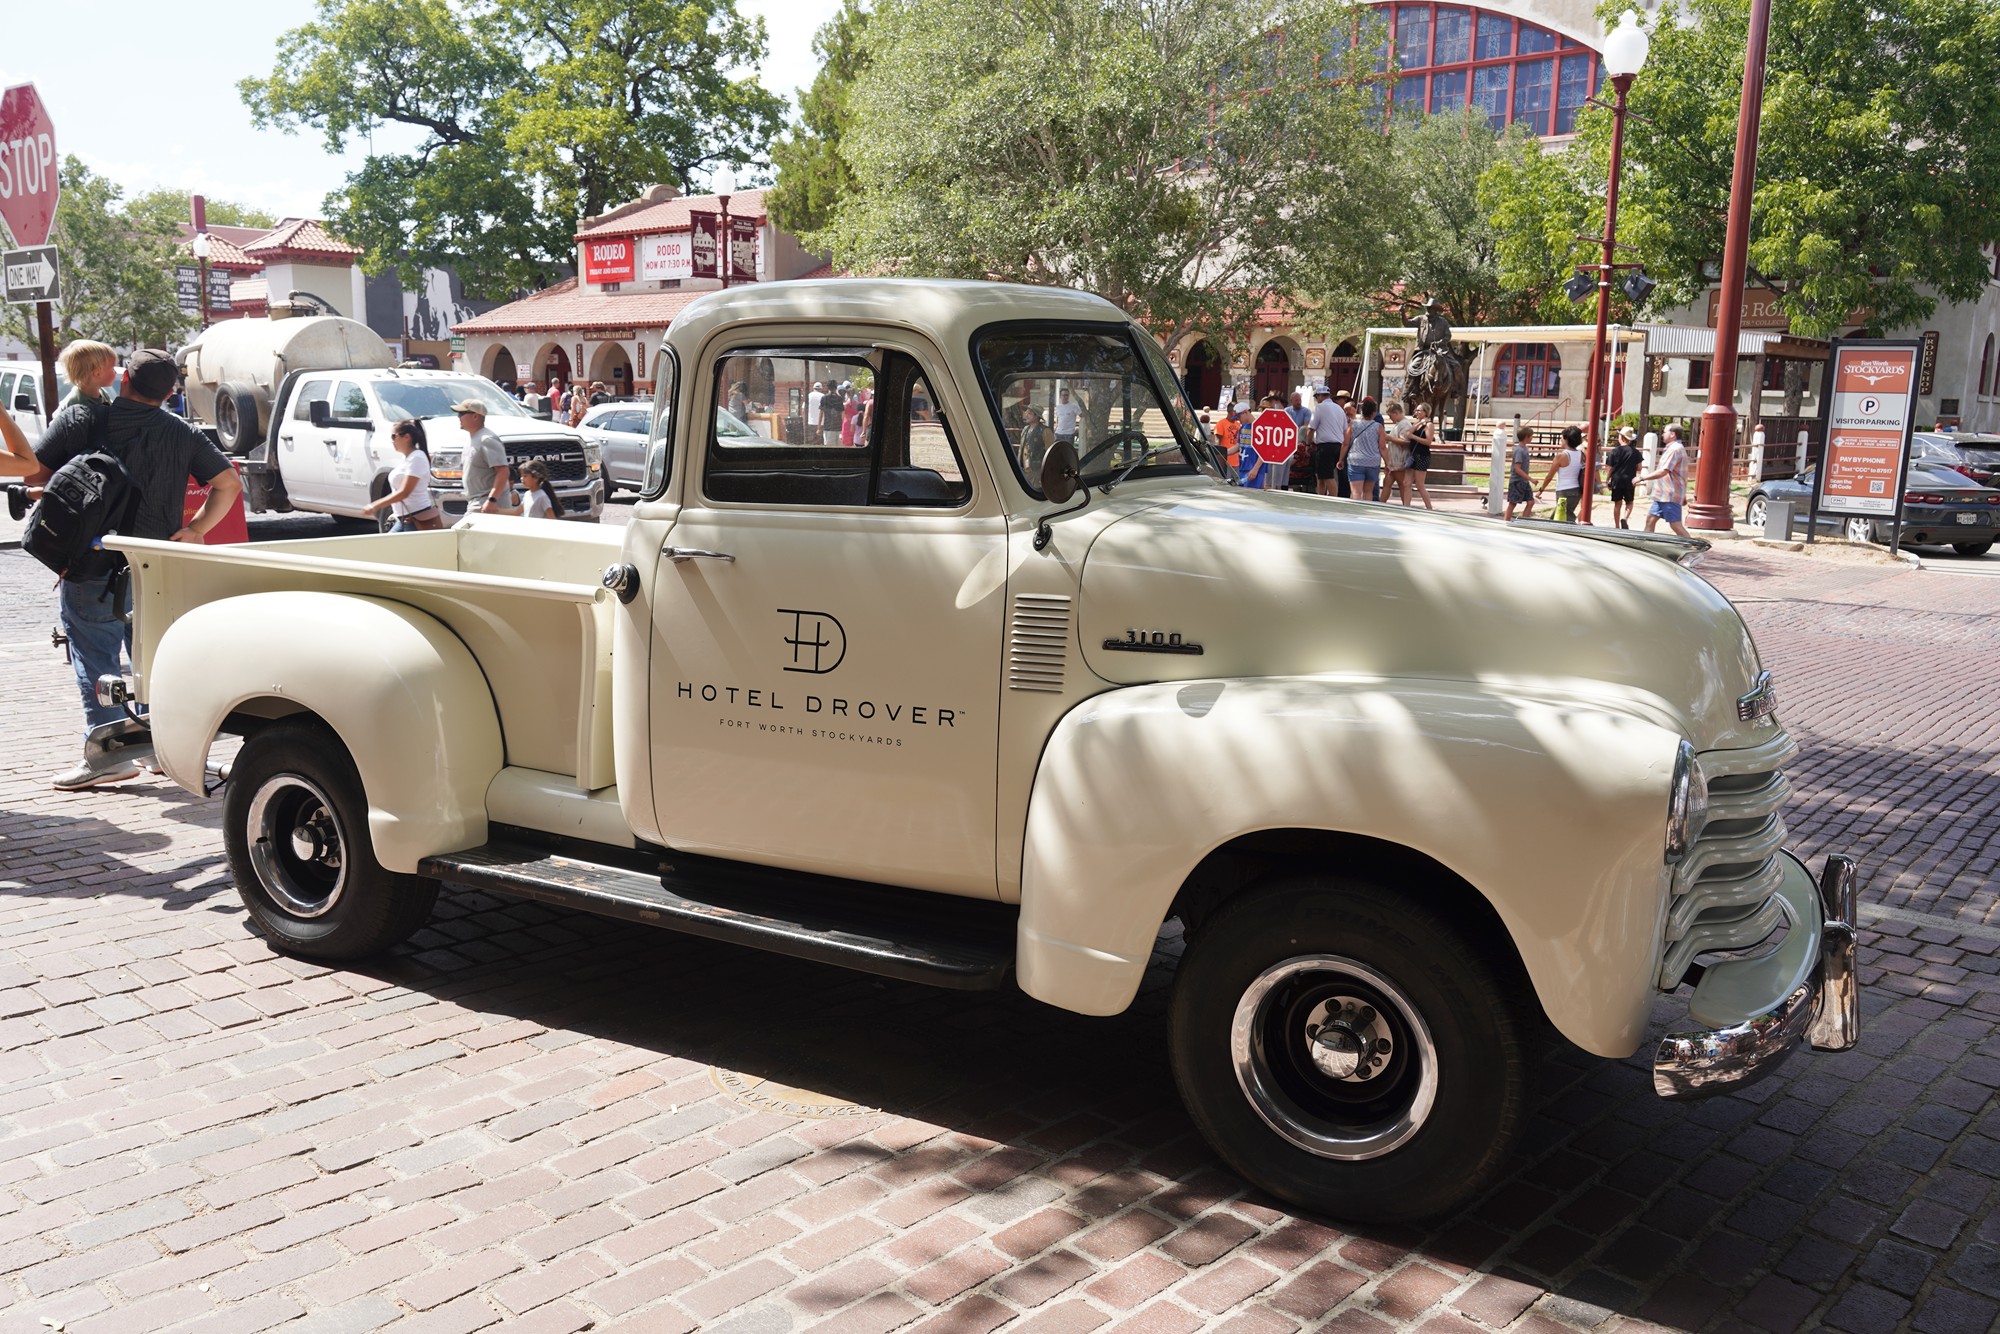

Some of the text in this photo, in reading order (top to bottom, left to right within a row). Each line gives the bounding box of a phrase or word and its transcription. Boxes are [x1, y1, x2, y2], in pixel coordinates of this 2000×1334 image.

[0, 132, 52, 199] STOP
[593, 243, 626, 261] RODEO
[657, 244, 680, 256] RODEO
[660, 260, 667, 268] AT
[667, 259, 680, 268] 7:30
[9, 264, 41, 287] ONE WAY
[1844, 365, 1904, 374] STOCKYARDS
[1921, 370, 1930, 392] SHOP
[1865, 400, 1875, 412] P
[1866, 418, 1901, 426] PARKING
[1254, 425, 1295, 447] STOP
[516, 454, 560, 463] RAM
[1125, 628, 1182, 646] 3100
[678, 682, 784, 710] HOTEL
[719, 718, 902, 747] FORT WORTH STOCKYARDS
